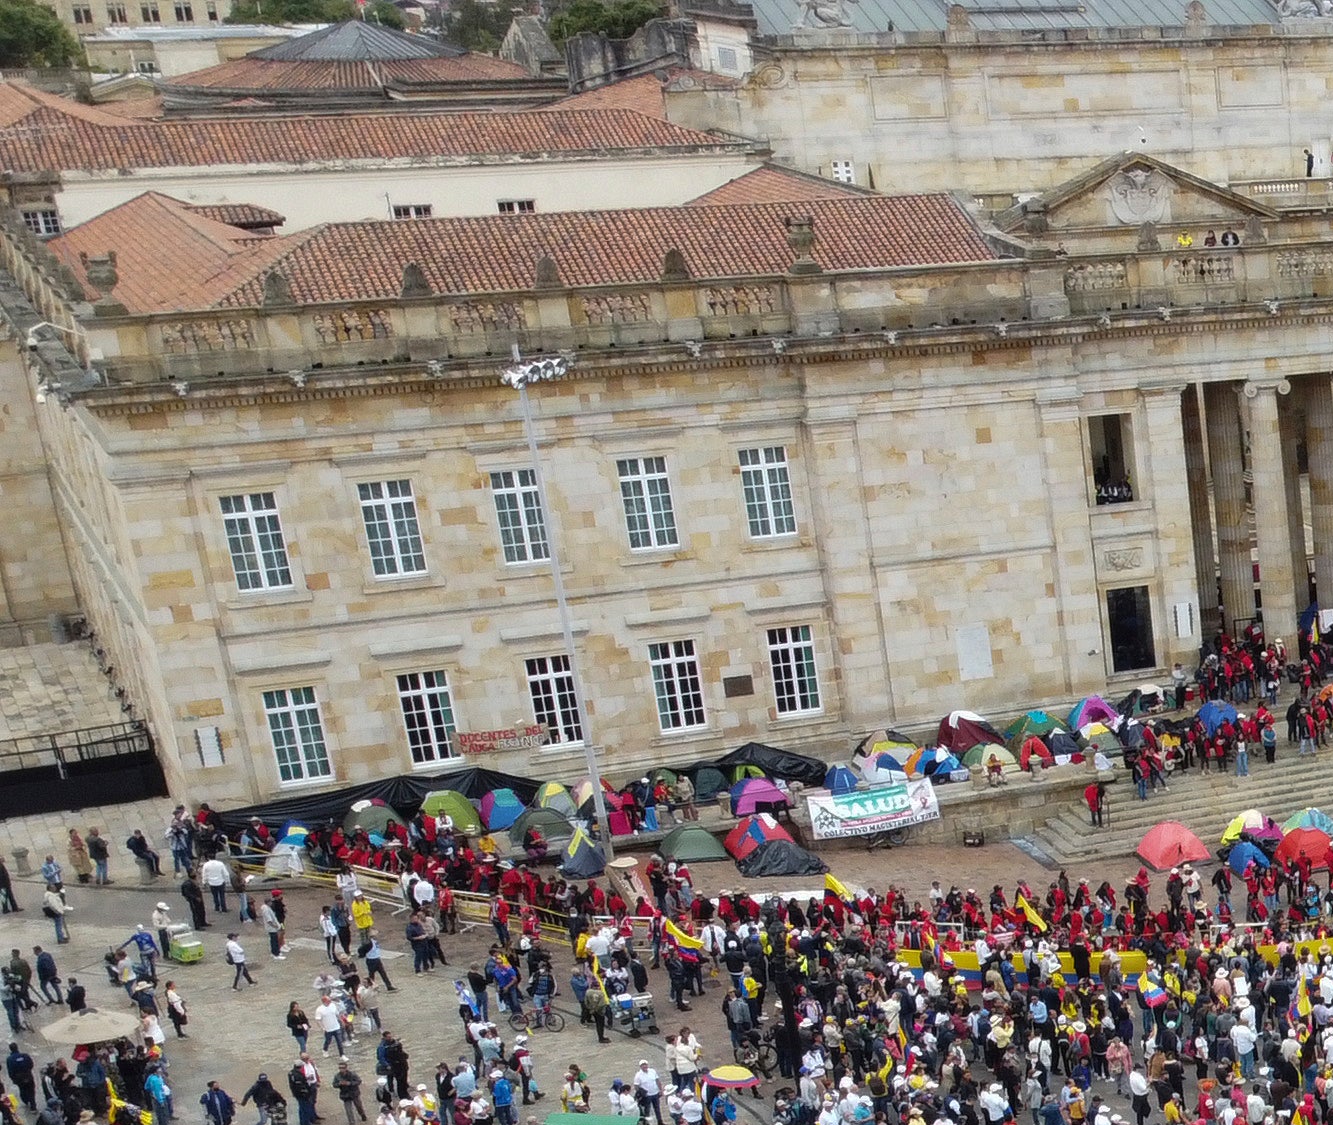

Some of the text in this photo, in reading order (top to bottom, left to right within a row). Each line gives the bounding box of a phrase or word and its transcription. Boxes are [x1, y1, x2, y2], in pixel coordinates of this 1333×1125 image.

[459, 725, 544, 745] DOCENTES DEL
[836, 793, 910, 819] SALUD
